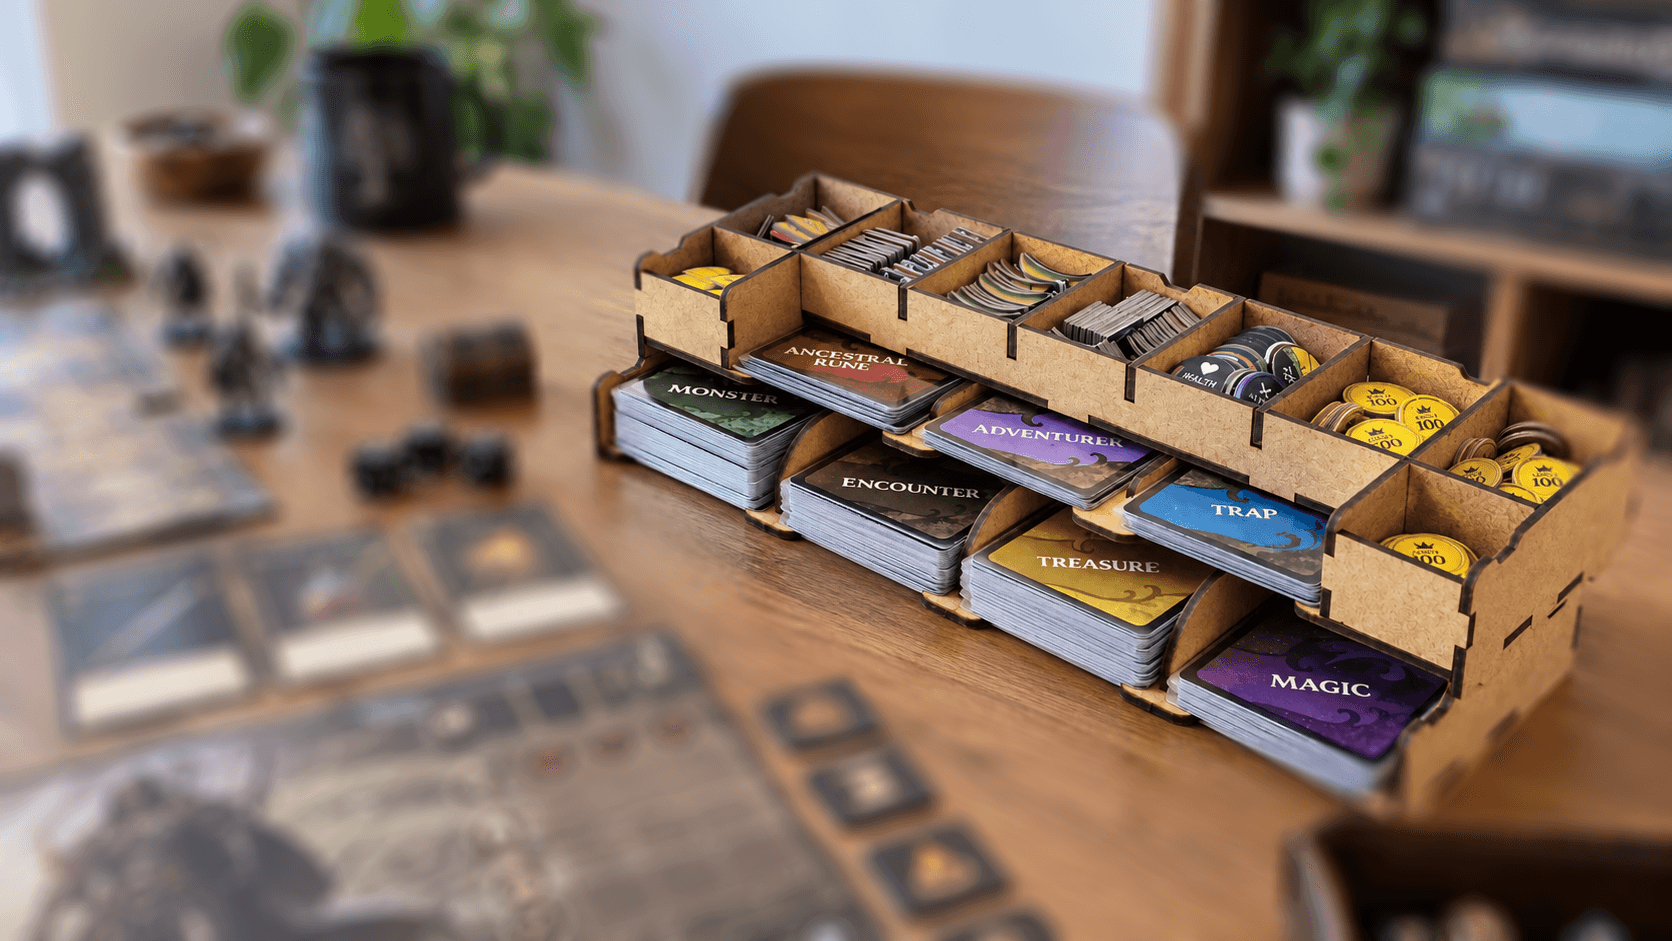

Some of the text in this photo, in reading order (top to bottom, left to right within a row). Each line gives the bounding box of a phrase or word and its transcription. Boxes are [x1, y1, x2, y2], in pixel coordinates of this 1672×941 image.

[784, 346, 909, 367] ANCESTRAL
[813, 357, 871, 371] RUNE
[668, 383, 778, 405] MONSTER
[1369, 397, 1398, 407] 100
[1416, 418, 1445, 431] 100
[971, 423, 1124, 448] ADVENTURER
[1373, 438, 1403, 450] 00
[841, 477, 981, 499] ENCOUNTER
[1532, 477, 1564, 488] 100
[1211, 503, 1278, 520] TRAP
[1036, 556, 1160, 574] TREASURE
[1270, 673, 1371, 698] MAGIC
